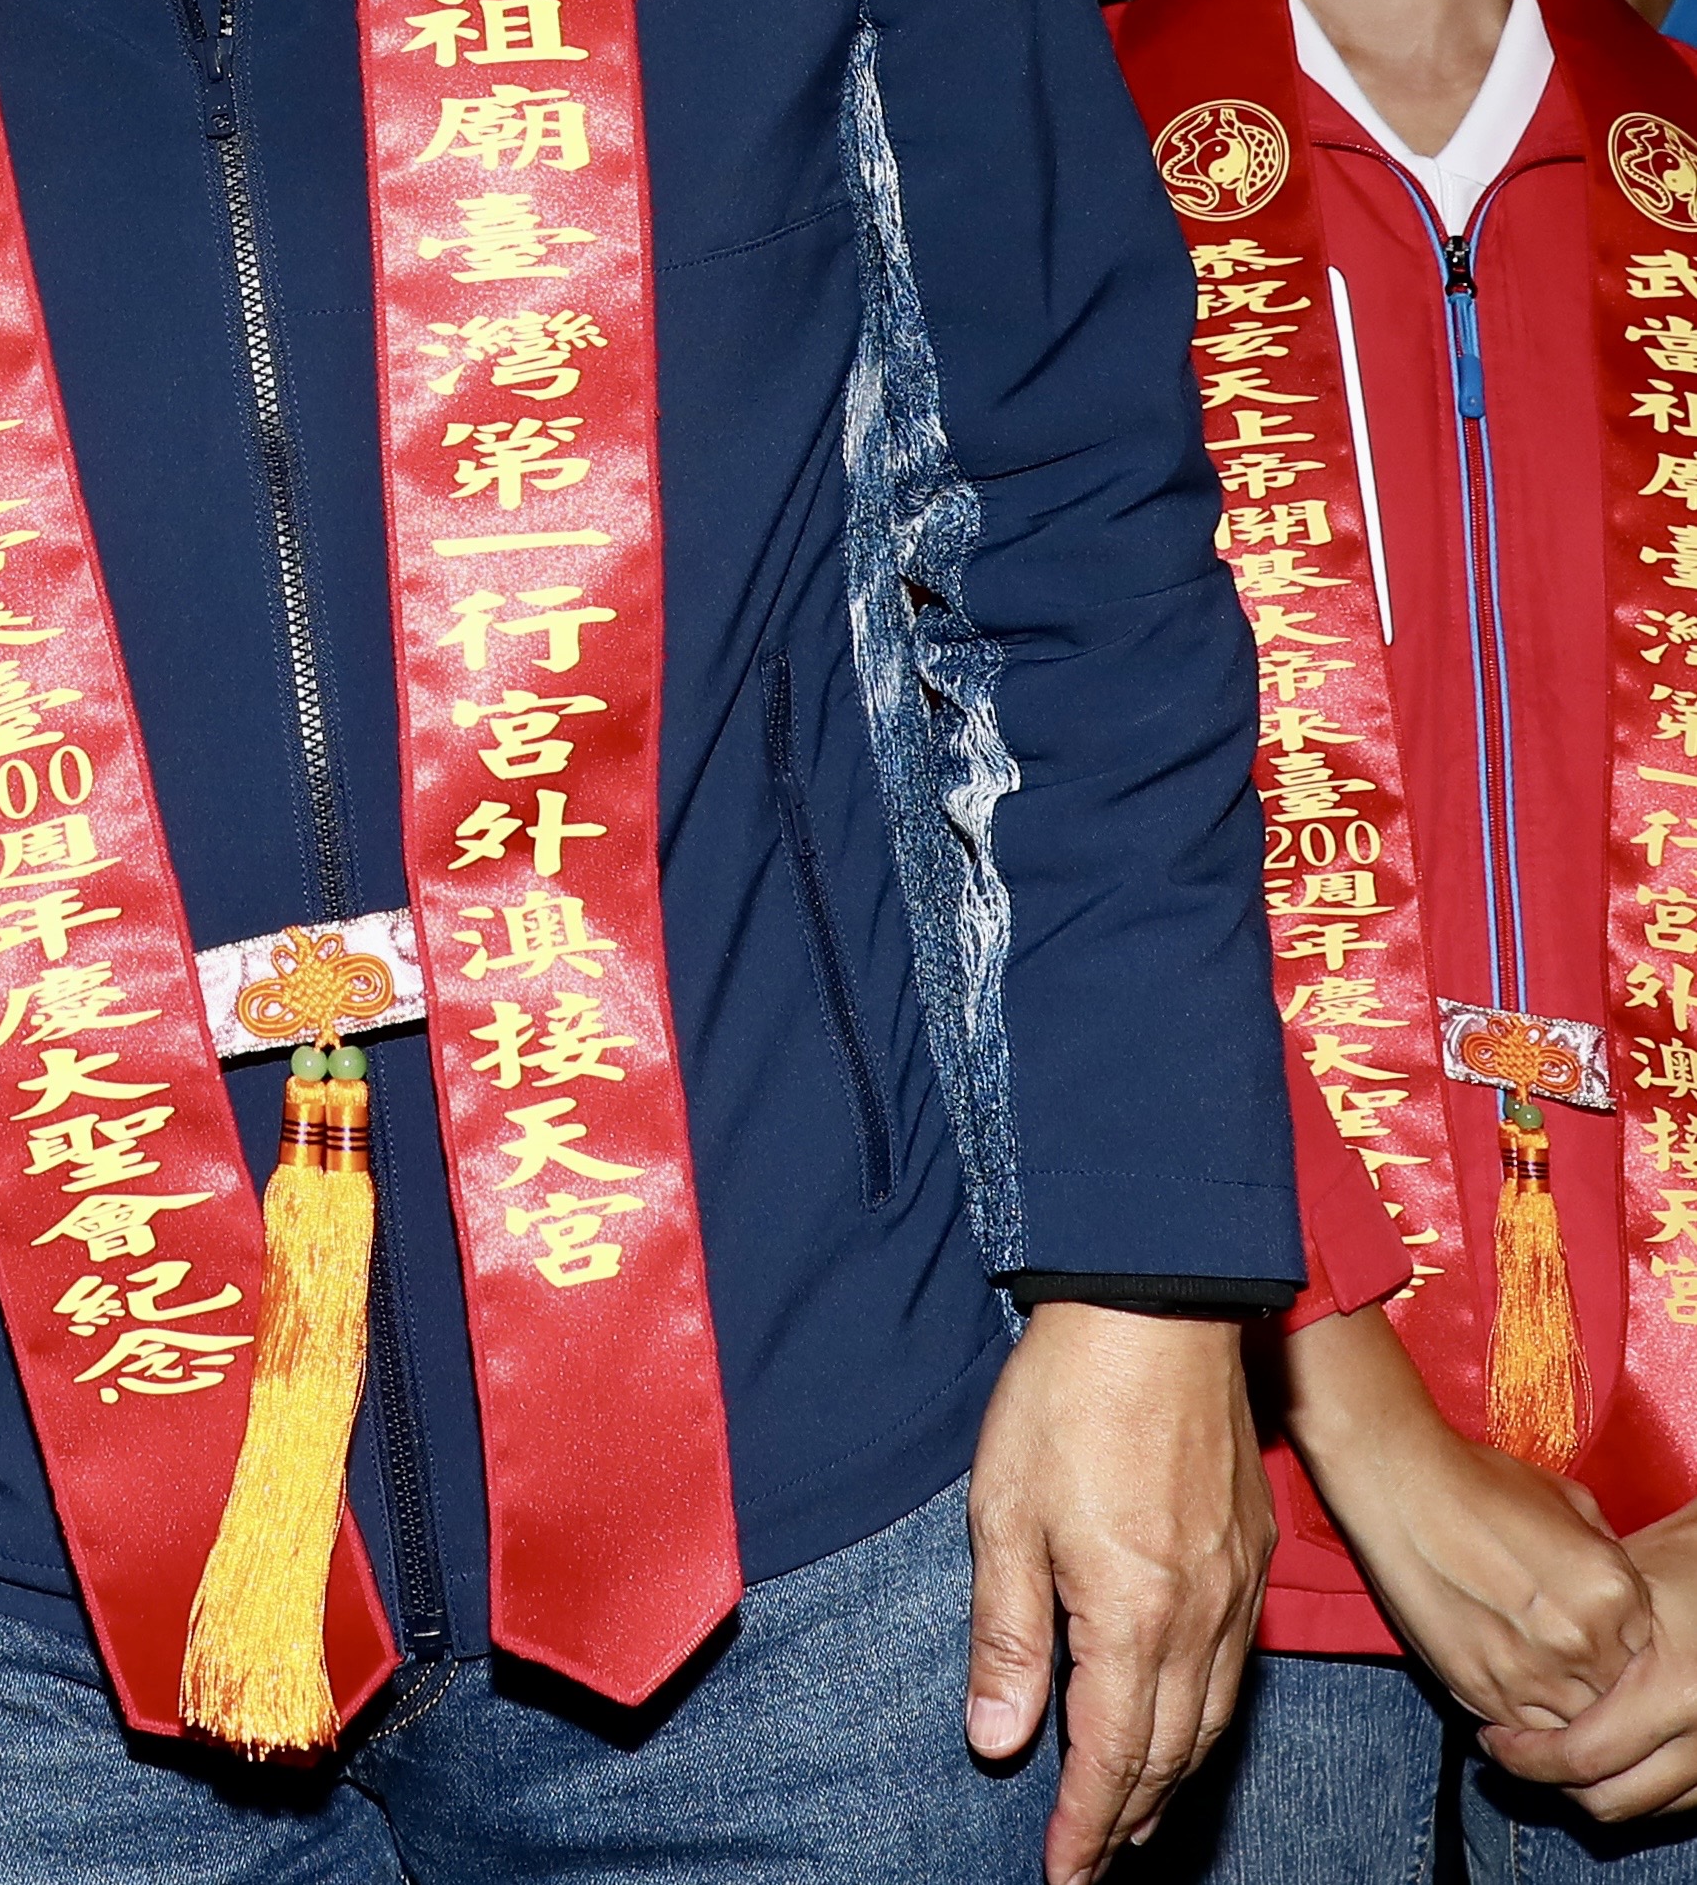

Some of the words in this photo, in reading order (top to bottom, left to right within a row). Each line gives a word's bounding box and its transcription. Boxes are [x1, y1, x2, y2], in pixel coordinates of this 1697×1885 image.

[1188, 238, 1445, 1300] 恭祝玄天上帝開基大帝來臺200週年慶大聖
